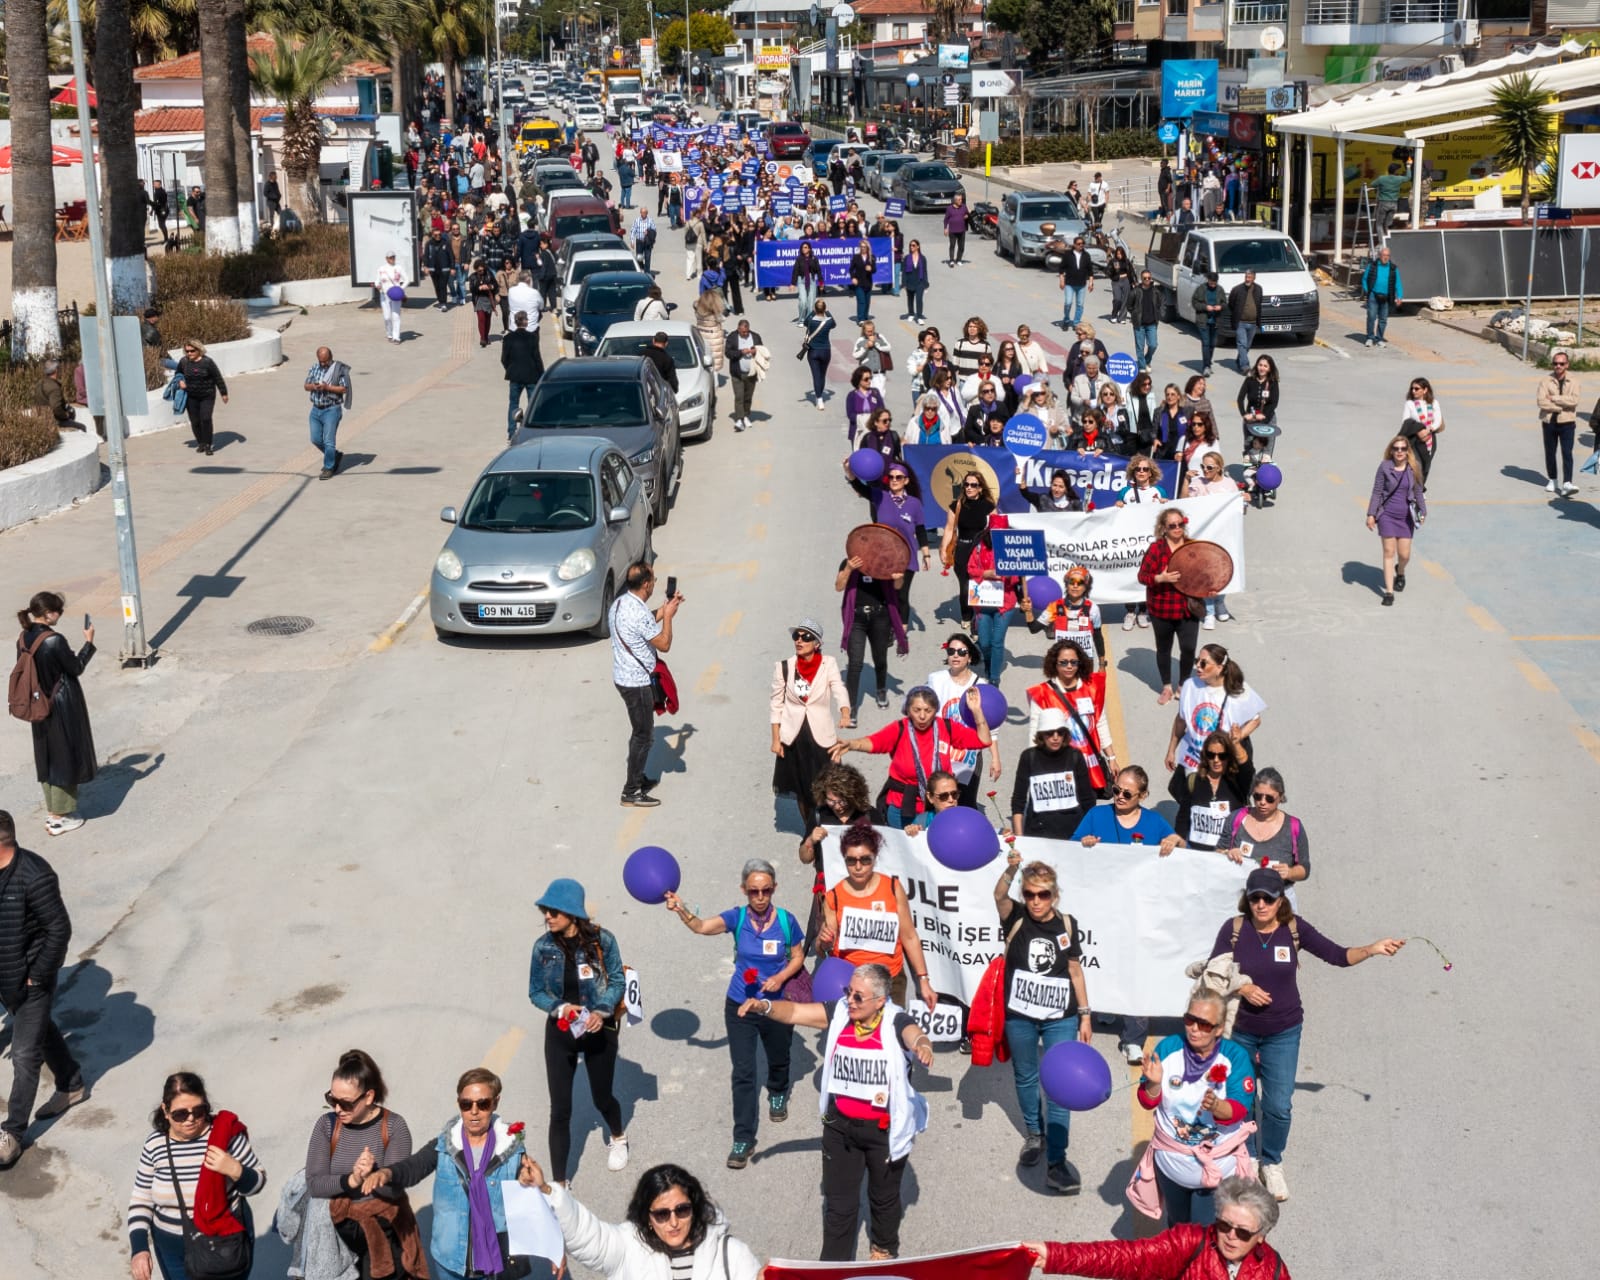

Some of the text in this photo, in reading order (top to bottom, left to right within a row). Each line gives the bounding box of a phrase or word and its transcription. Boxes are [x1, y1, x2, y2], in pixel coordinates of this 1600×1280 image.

[756, 55, 789, 65] OTOPARK
[1177, 78, 1203, 88] MARİN
[1174, 89, 1206, 97] MARKET
[781, 249, 799, 257] MART
[822, 246, 853, 255] KADINLAR
[1004, 535, 1033, 545] KADIN
[1060, 539, 1108, 553] SONLAR
[1004, 548, 1035, 560] YAŞAM
[997, 559, 1046, 571] ÖZGÜRLÜK
[484, 606, 535, 616] 09 NN 416
[843, 914, 898, 945] YAŞAMHAK
[923, 916, 952, 940] BİR
[957, 921, 991, 947] İŞE
[1014, 976, 1069, 1011] YAŞAMHAK
[833, 1053, 888, 1090] YAŞAMHAK
